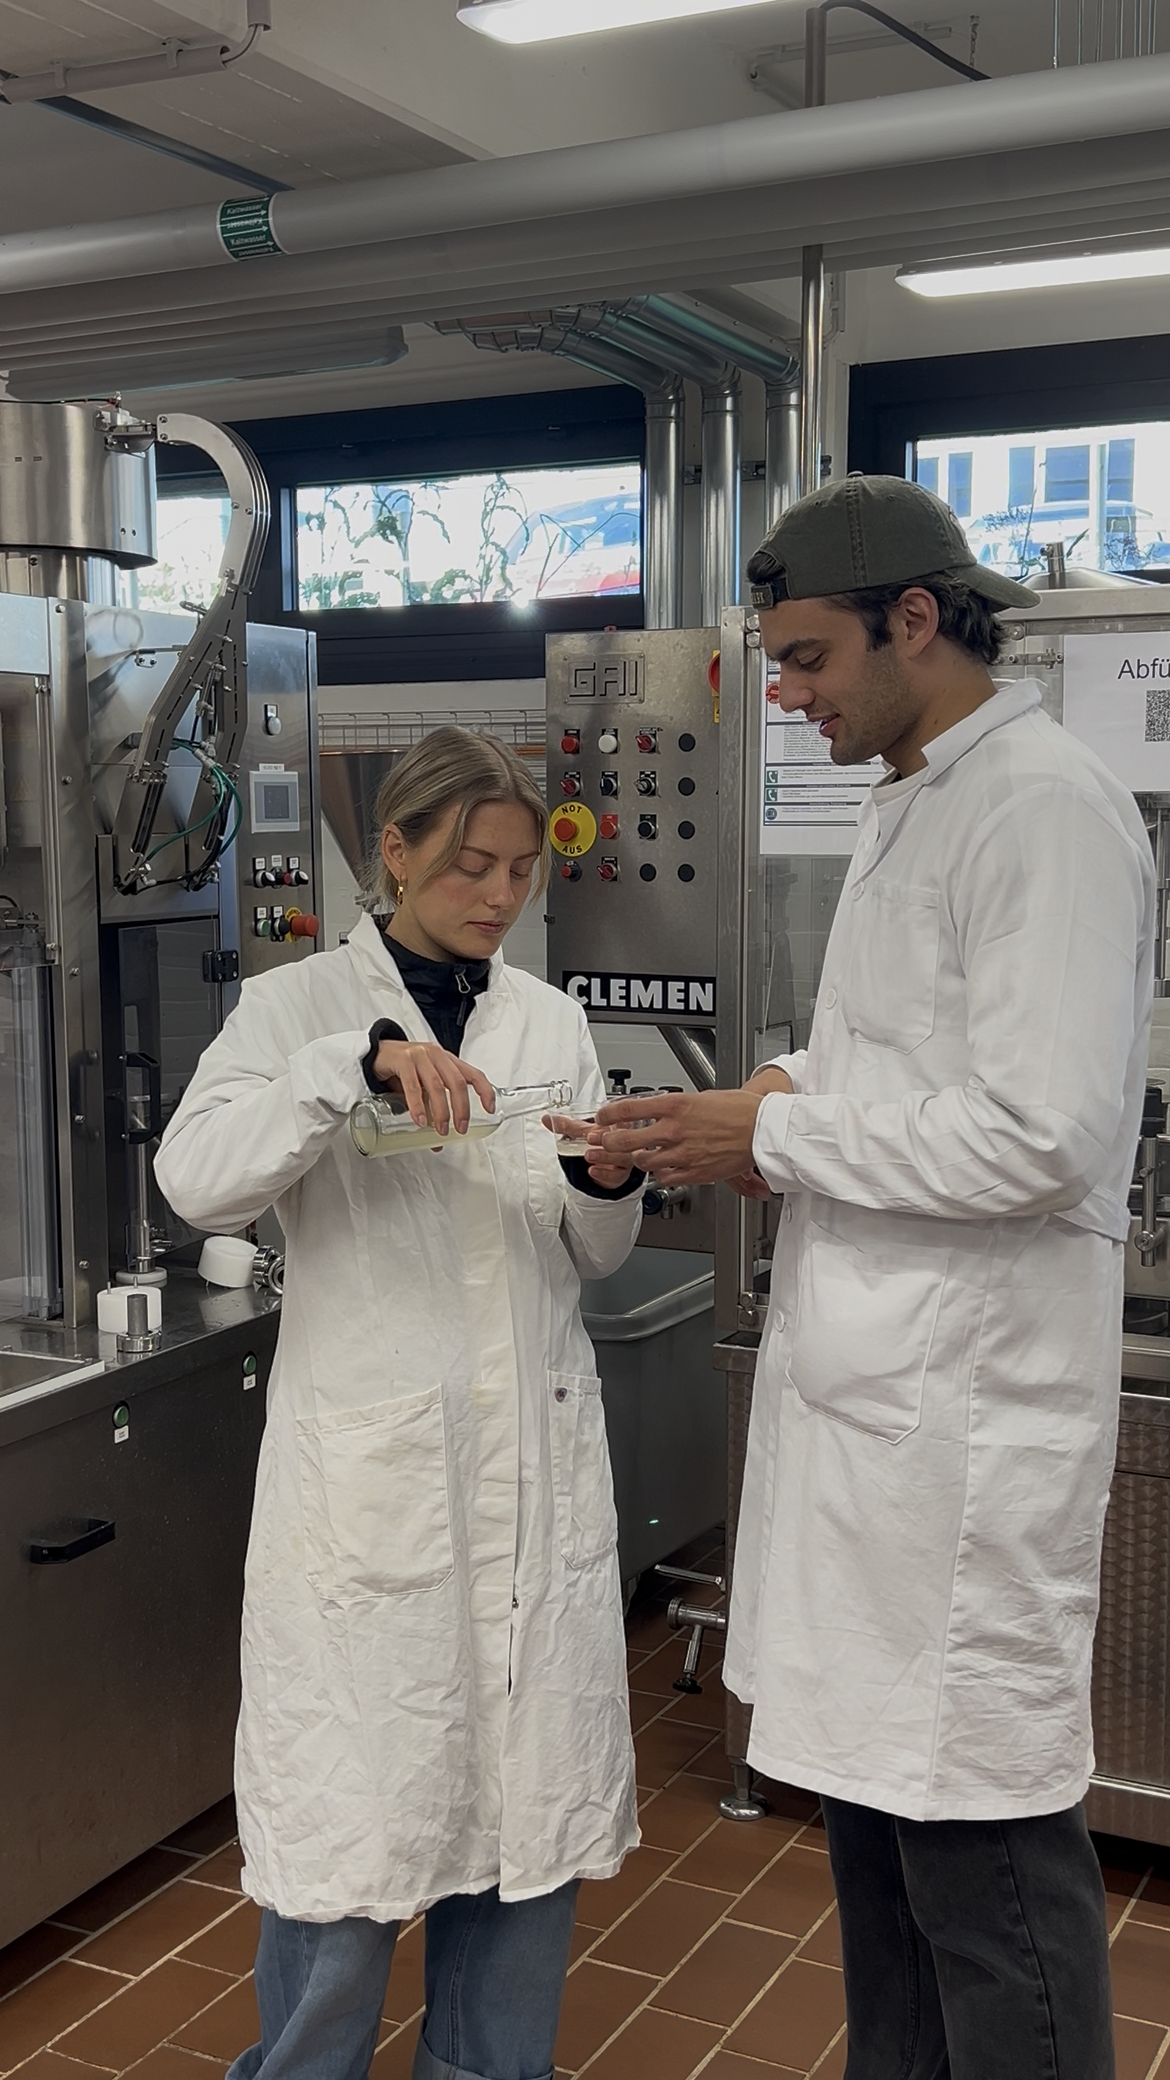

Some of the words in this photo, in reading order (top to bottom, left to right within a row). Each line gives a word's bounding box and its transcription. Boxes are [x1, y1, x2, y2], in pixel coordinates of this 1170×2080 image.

[561, 805, 582, 815] NOT
[562, 845, 583, 855] AUS
[567, 975, 714, 1012] CLEMEN
